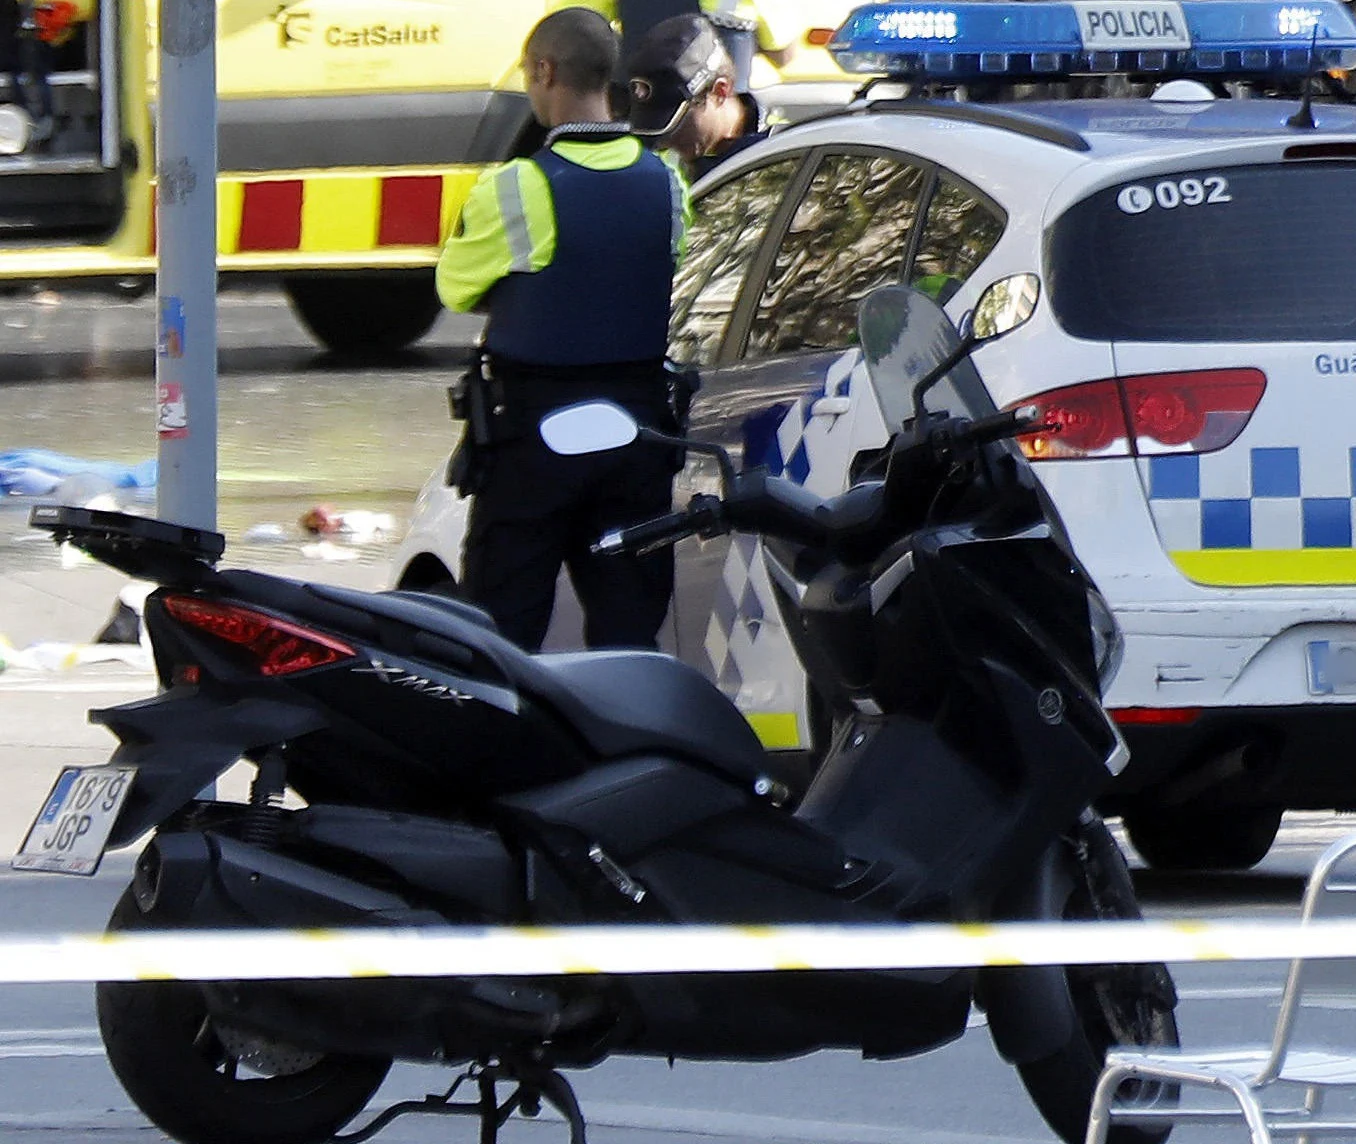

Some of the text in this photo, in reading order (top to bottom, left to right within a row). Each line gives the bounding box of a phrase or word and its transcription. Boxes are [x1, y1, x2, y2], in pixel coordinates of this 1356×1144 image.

[325, 23, 441, 47] CatSalut
[1087, 10, 1177, 36] POLICIA
[1154, 175, 1232, 210] 092
[65, 773, 127, 812] 1679
[43, 814, 93, 851] JGP
